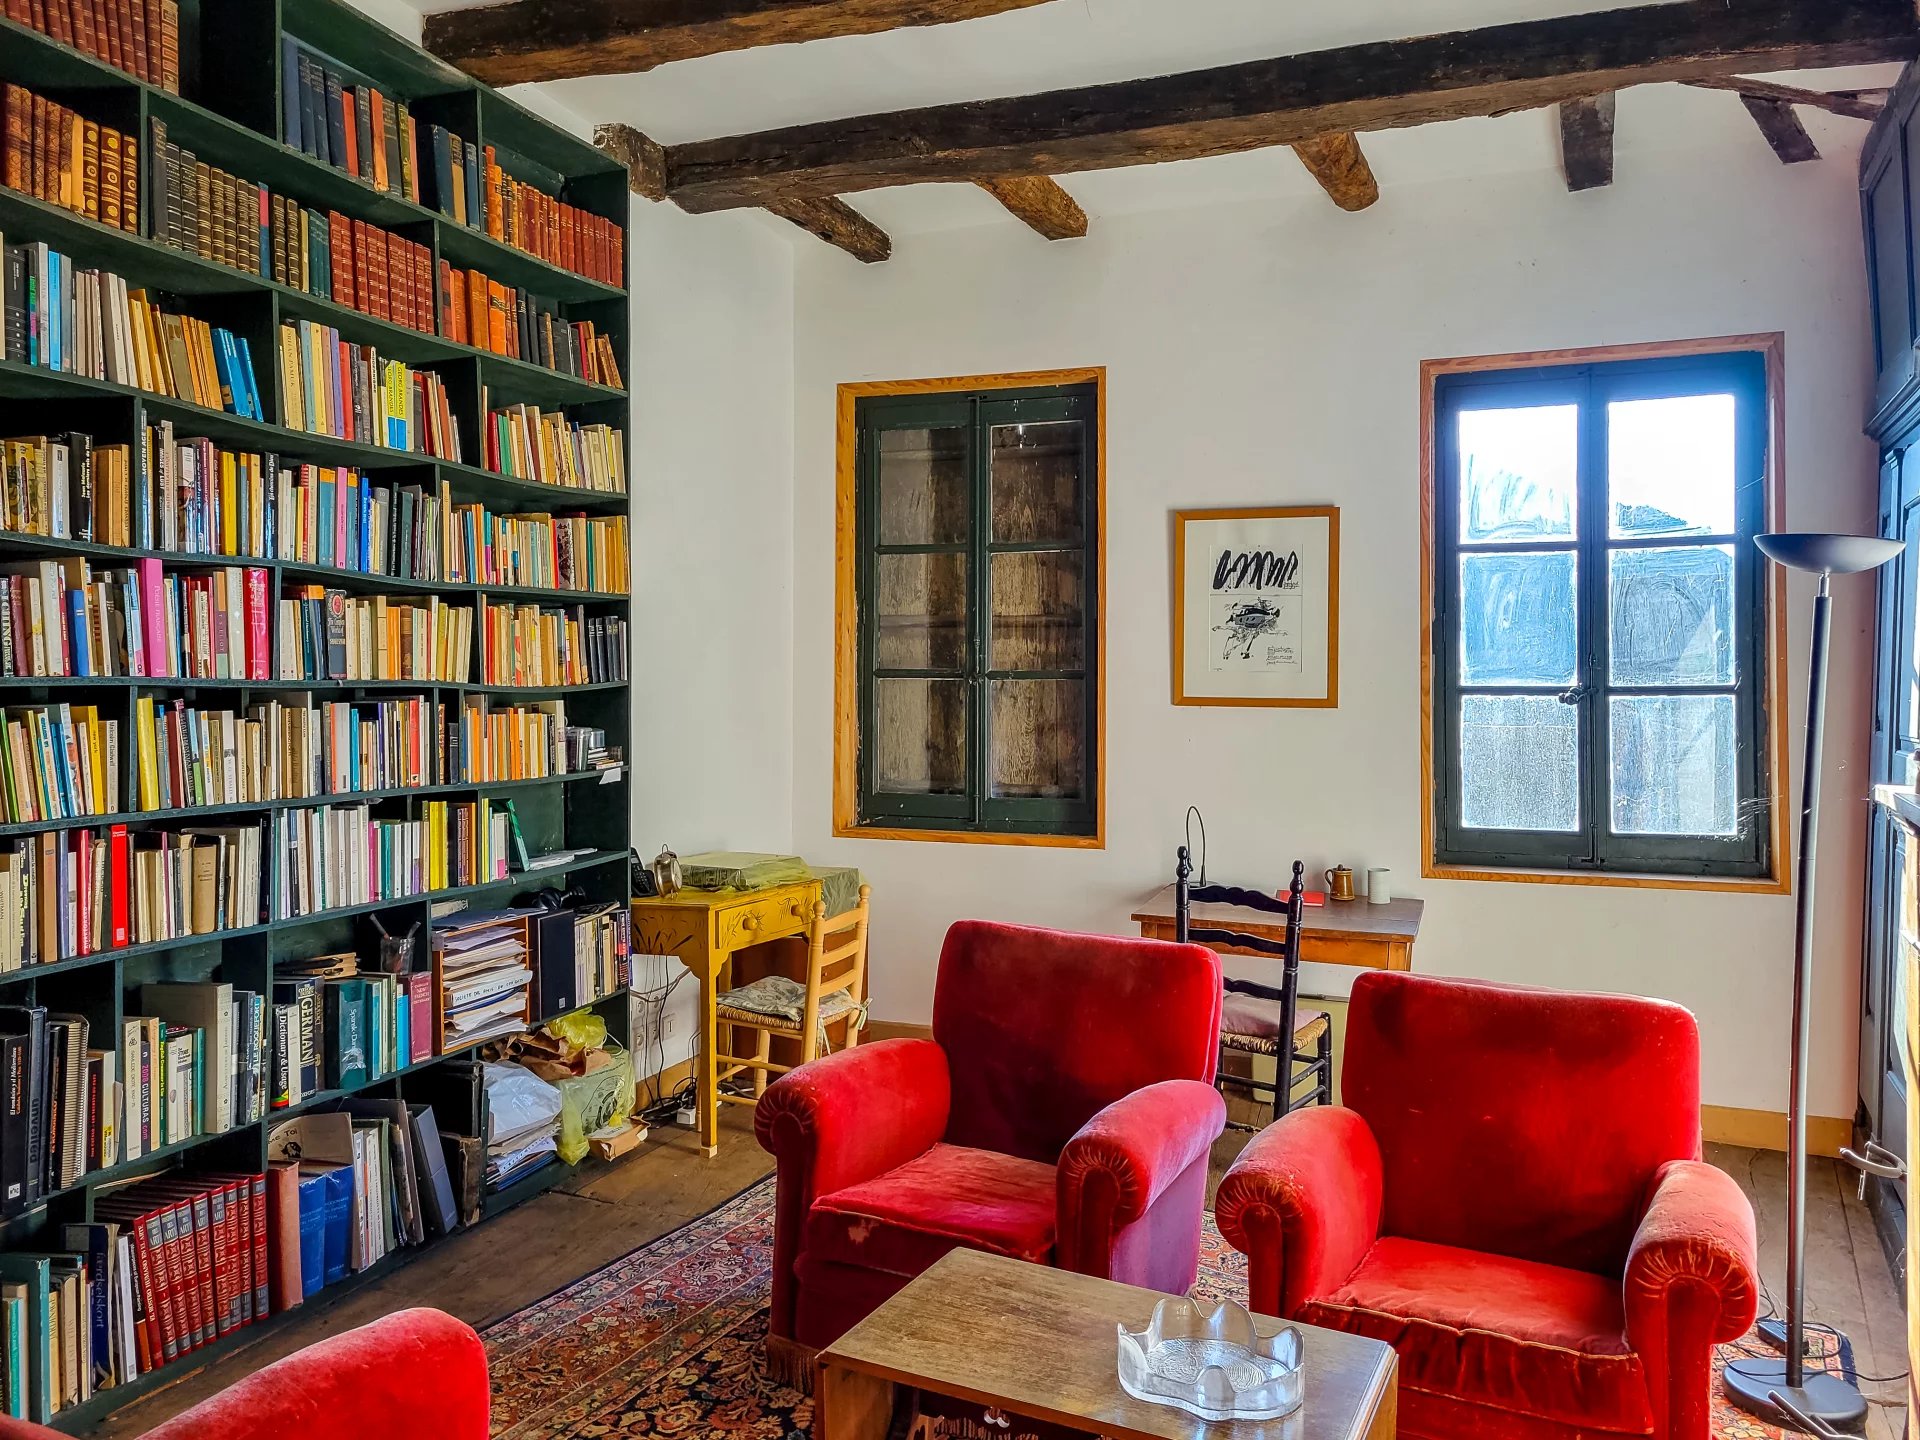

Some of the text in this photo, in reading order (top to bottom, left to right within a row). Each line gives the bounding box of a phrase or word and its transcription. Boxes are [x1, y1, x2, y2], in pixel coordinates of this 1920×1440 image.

[278, 1016, 288, 1057] Dictionary
[301, 998, 313, 1061] GERMAN
[279, 1066, 289, 1090] Usage
[95, 1252, 106, 1329] færdselskort
